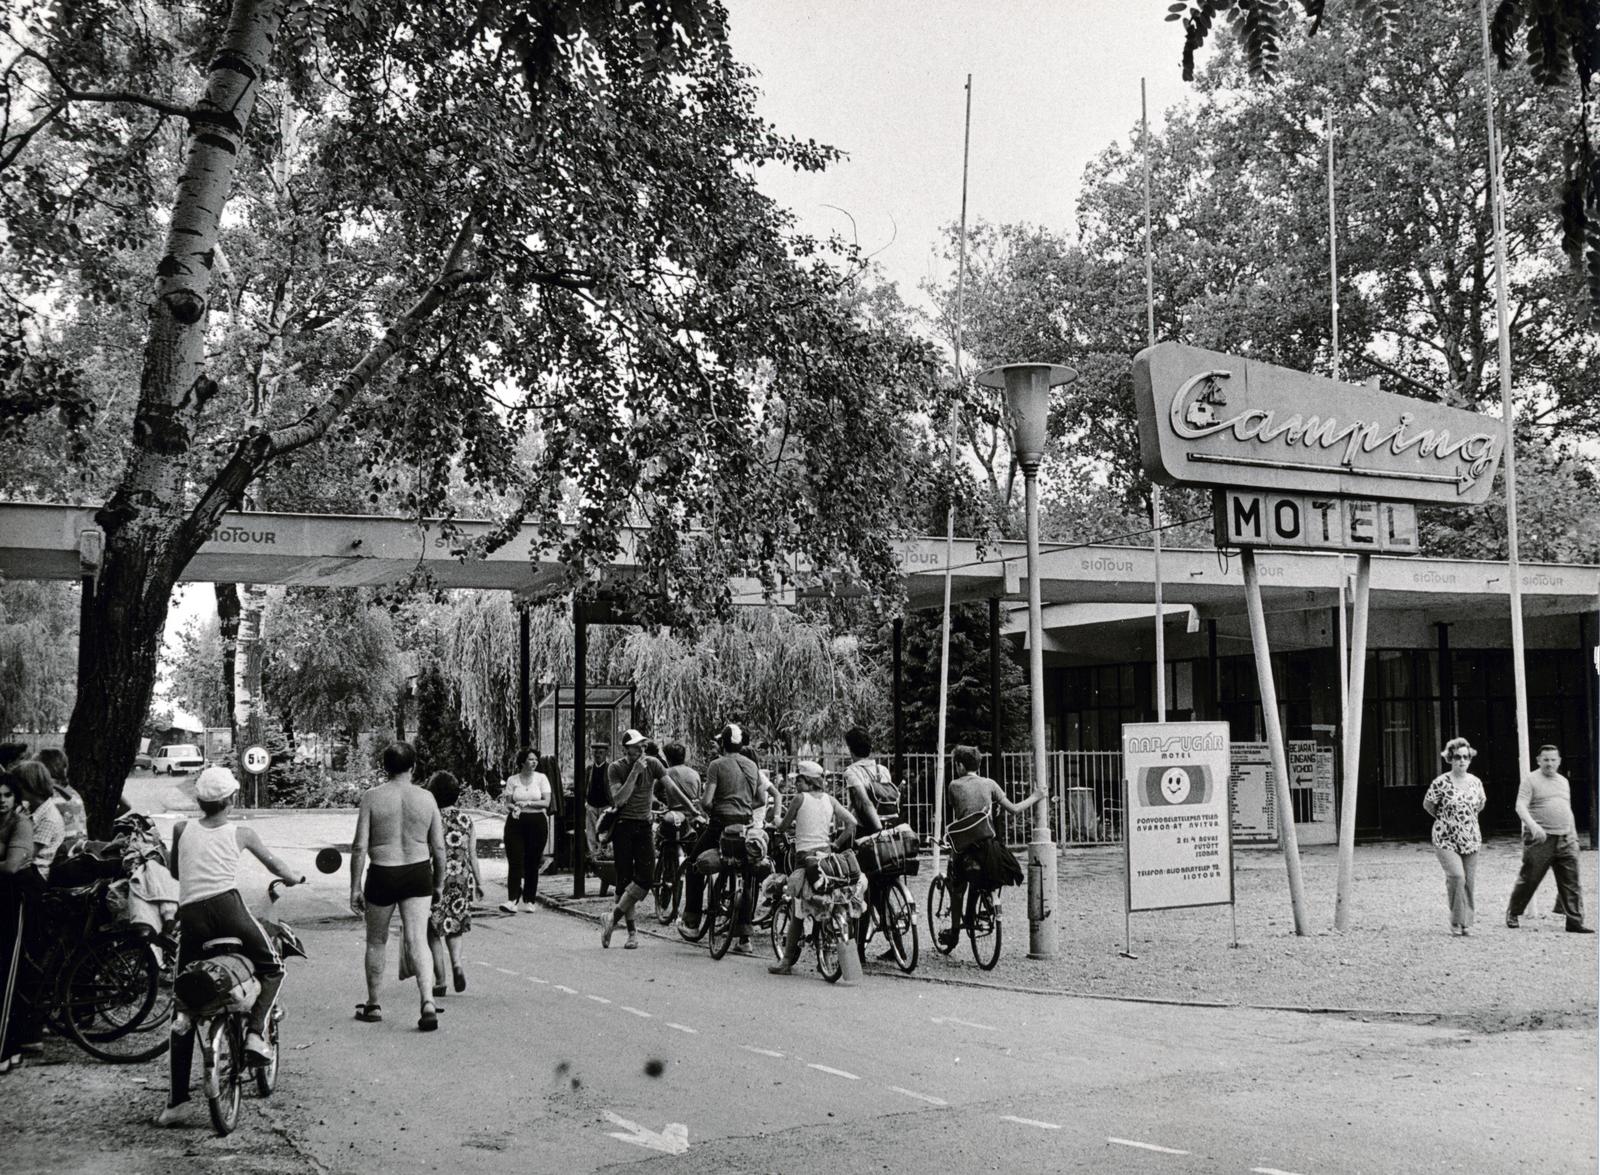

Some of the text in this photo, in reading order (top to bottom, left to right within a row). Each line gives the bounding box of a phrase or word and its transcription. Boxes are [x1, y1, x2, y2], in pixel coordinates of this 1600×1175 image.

[1170, 370, 1498, 476] Camping
[1233, 496, 1413, 546] MOTEL
[1081, 557, 1133, 572] SIOTOUR
[1413, 570, 1456, 584] SIOTOUR
[1522, 574, 1564, 586] SIOTOUR
[1129, 732, 1224, 753] NAPSUGÁR
[248, 753, 255, 765] 5
[1161, 752, 1191, 760] MOTEL
[1290, 754, 1316, 763] EINGANG
